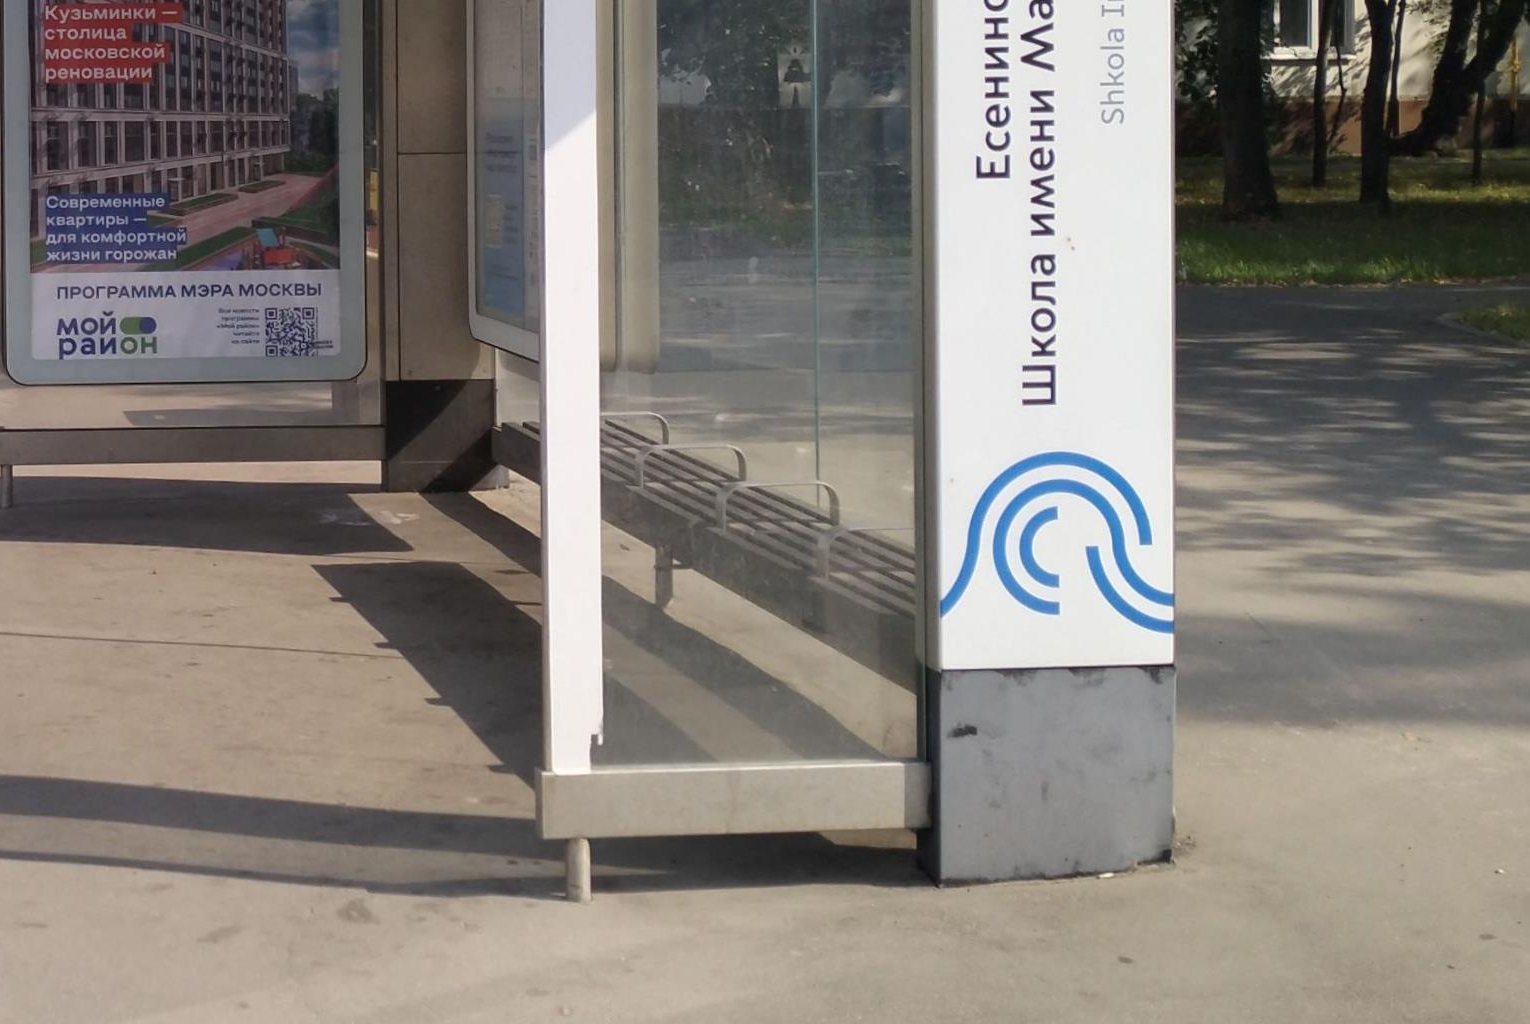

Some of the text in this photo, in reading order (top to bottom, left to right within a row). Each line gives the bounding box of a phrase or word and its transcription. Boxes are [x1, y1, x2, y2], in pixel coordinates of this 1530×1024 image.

[45, 5, 156, 23] Кузьминки
[44, 27, 127, 40] столица
[45, 43, 165, 60] московской
[45, 66, 152, 83] реновации
[1100, 28, 1125, 125] Shkola
[1028, 89, 1056, 236] имени
[46, 195, 166, 211] Современные
[46, 214, 129, 228] квартиры
[45, 229, 187, 245] для комфортной
[46, 248, 177, 263] жизни горожан
[56, 282, 322, 299] ПРОГРАММА МЭРА МОСКВЫ
[56, 310, 118, 336] мой
[1022, 254, 1057, 406] Школа
